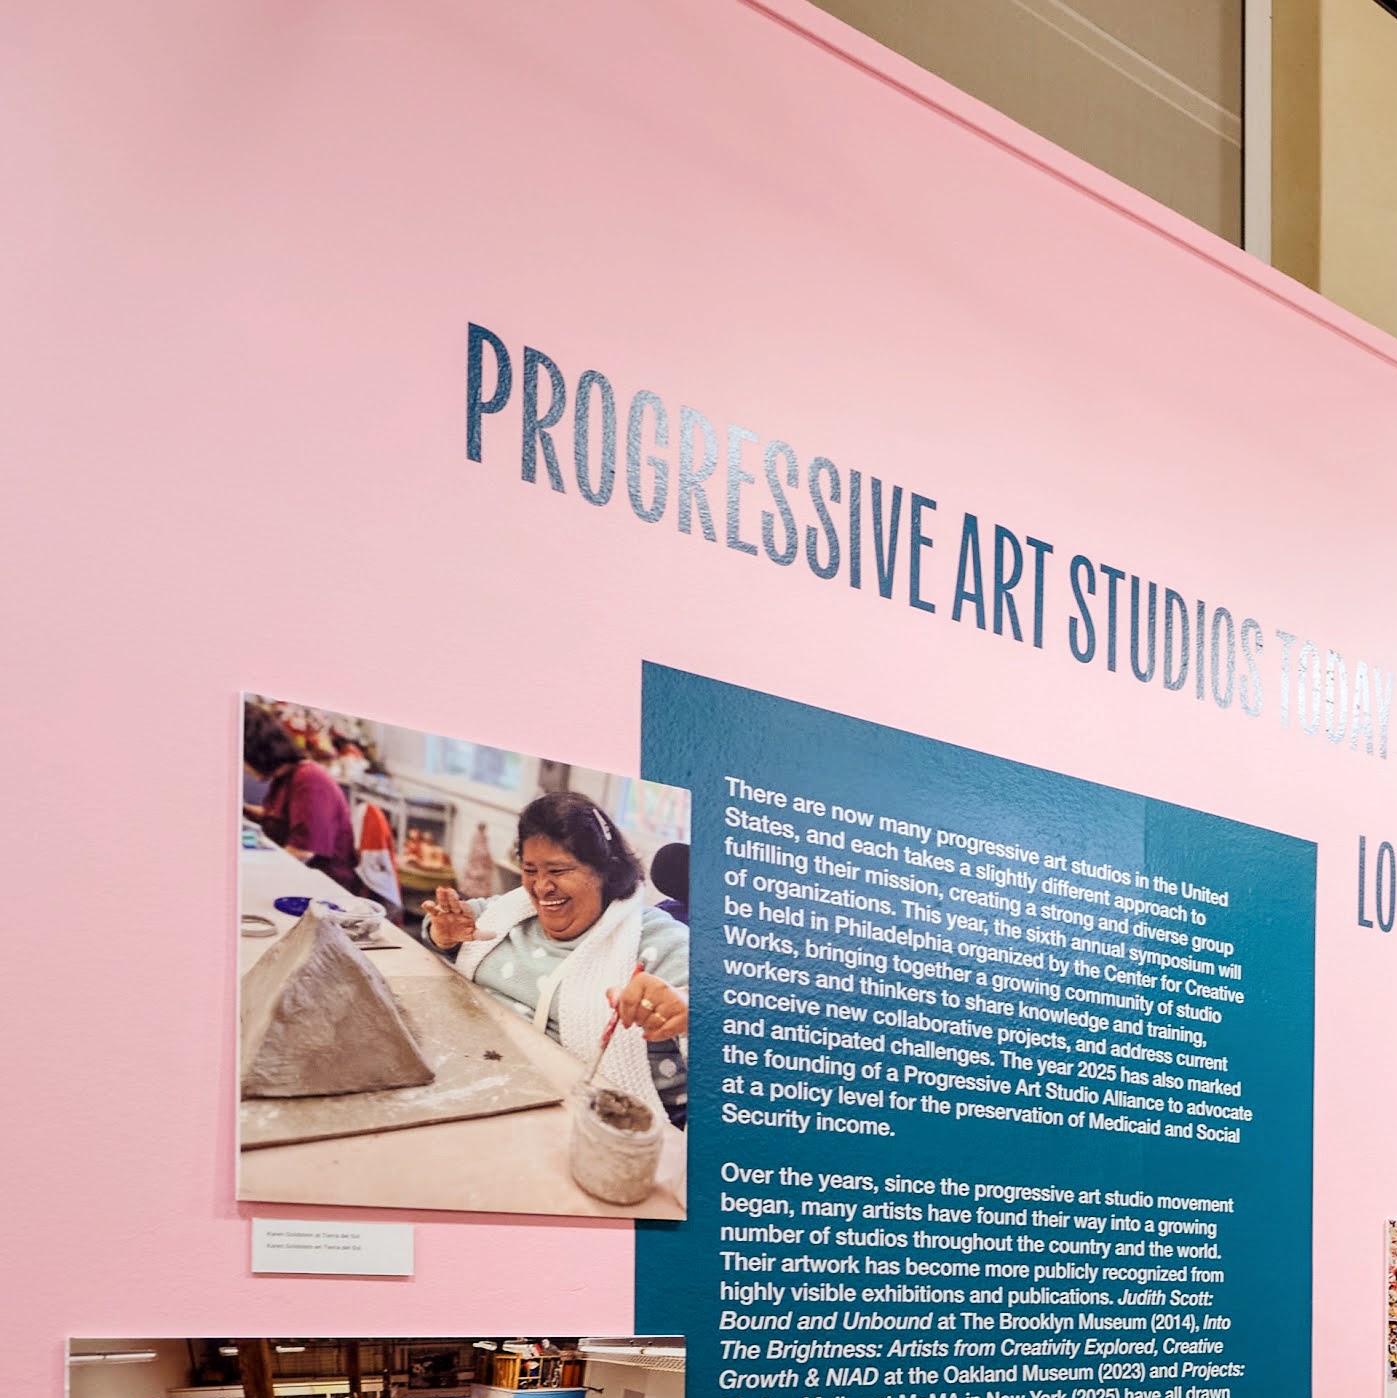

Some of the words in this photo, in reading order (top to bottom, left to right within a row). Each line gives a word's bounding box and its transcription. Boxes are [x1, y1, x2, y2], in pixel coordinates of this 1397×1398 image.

[465, 321, 937, 613] PROGRESSIVE
[951, 513, 1054, 649] ART
[1068, 555, 1265, 719] STUDIOS
[1274, 629, 1397, 758] TODAY
[724, 775, 788, 809] There
[792, 796, 827, 817] are
[831, 805, 875, 828] now
[879, 816, 932, 845] many
[936, 829, 1040, 865] progressive
[1043, 854, 1068, 872] art
[1071, 859, 1132, 886] studios
[1135, 871, 1150, 890] in
[1152, 876, 1179, 896] the
[1181, 881, 1230, 908] United
[724, 806, 801, 844] States,
[806, 828, 846, 850] and
[850, 838, 899, 862] each
[903, 846, 956, 873] takes
[959, 862, 972, 878] a
[975, 863, 1038, 894] slightly
[1041, 877, 1111, 907] different
[1113, 895, 1188, 923] approach
[1190, 908, 1207, 926] to
[724, 836, 809, 875] fulfilling
[813, 855, 861, 881] their
[865, 868, 945, 901] mission,
[949, 887, 1022, 918] creating
[1025, 902, 1038, 917] a
[1040, 904, 1095, 932] strong
[1098, 917, 1129, 935] and
[1132, 921, 1190, 947] diverse
[1191, 935, 1235, 958] group
[720, 1162, 775, 1185] Over
[778, 1166, 814, 1188] the
[817, 1173, 880, 1195] years,
[884, 1173, 937, 1195] since
[939, 1177, 971, 1197] the
[974, 1183, 1076, 1204] progressive
[1077, 1188, 1102, 1206] art
[1104, 1189, 1155, 1209] studio
[1156, 1195, 1235, 1214] movement
[720, 1191, 795, 1219] began,
[800, 1200, 859, 1223] many
[862, 1201, 924, 1222] artists
[927, 1203, 973, 1224] have
[975, 1206, 1028, 1227] found
[1030, 1210, 1072, 1229] their
[1073, 1215, 1108, 1234] way
[1110, 1214, 1142, 1233] into
[1143, 1219, 1156, 1233] a
[1157, 1219, 1218, 1240] growing
